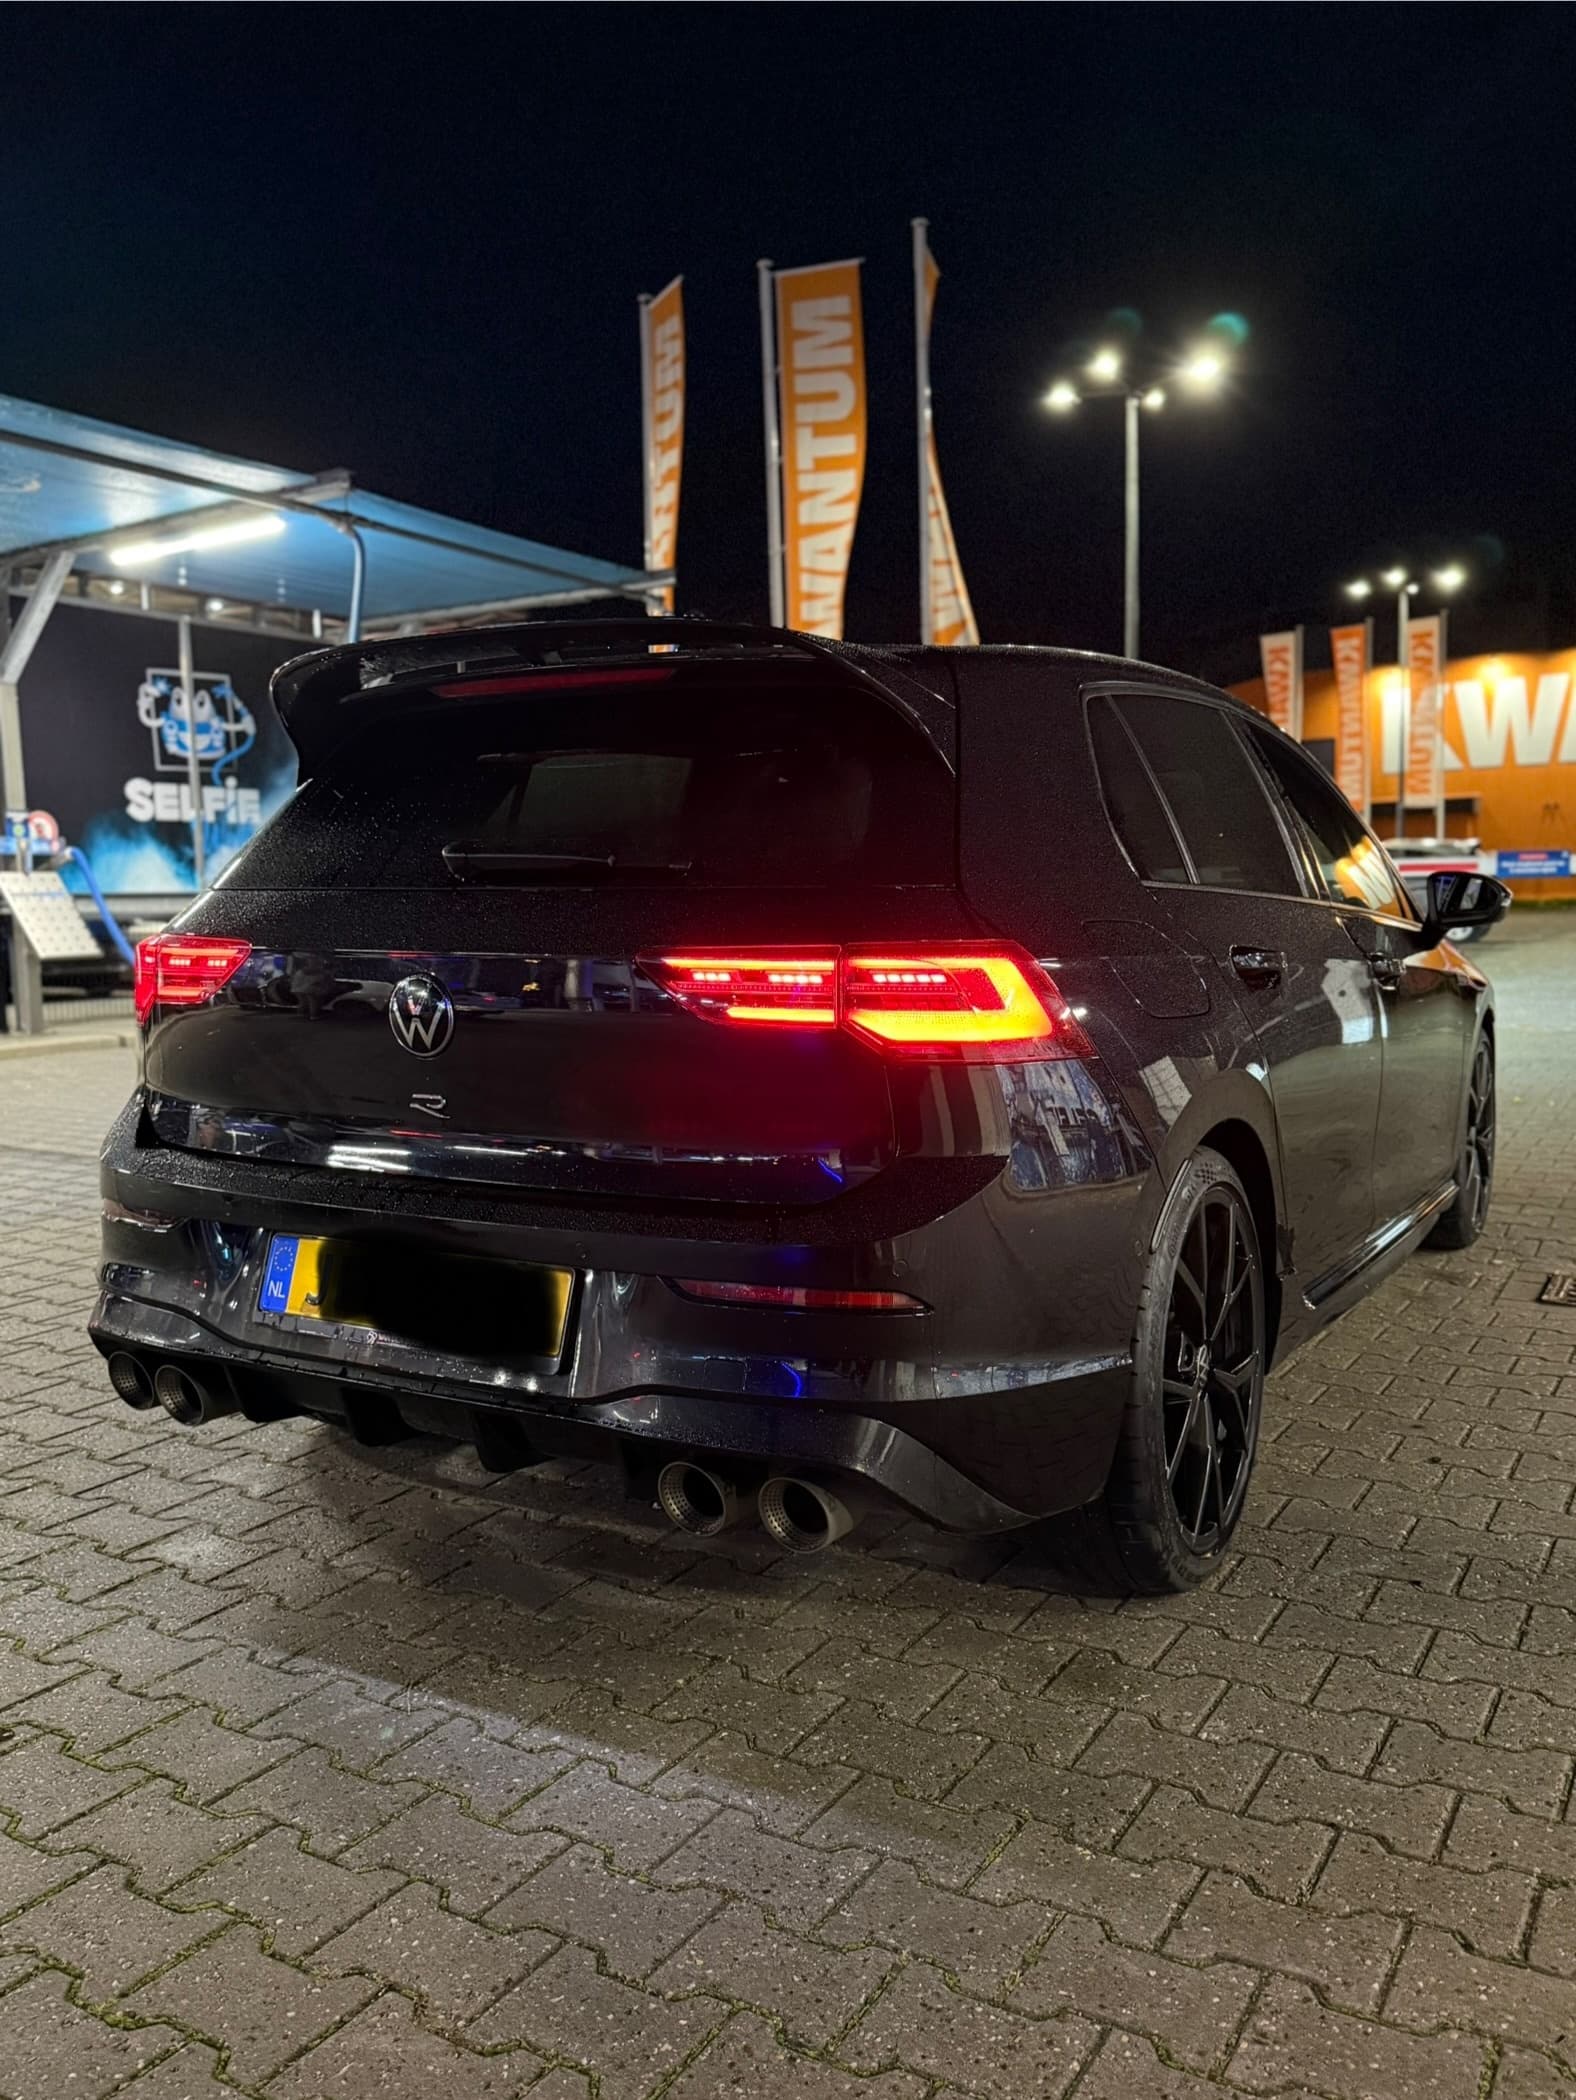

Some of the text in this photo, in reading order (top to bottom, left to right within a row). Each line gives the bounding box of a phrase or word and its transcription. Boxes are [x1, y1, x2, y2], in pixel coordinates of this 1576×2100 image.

[1382, 671, 1576, 775] KW
[409, 1093, 450, 1119] R
[267, 1279, 285, 1298] NL
